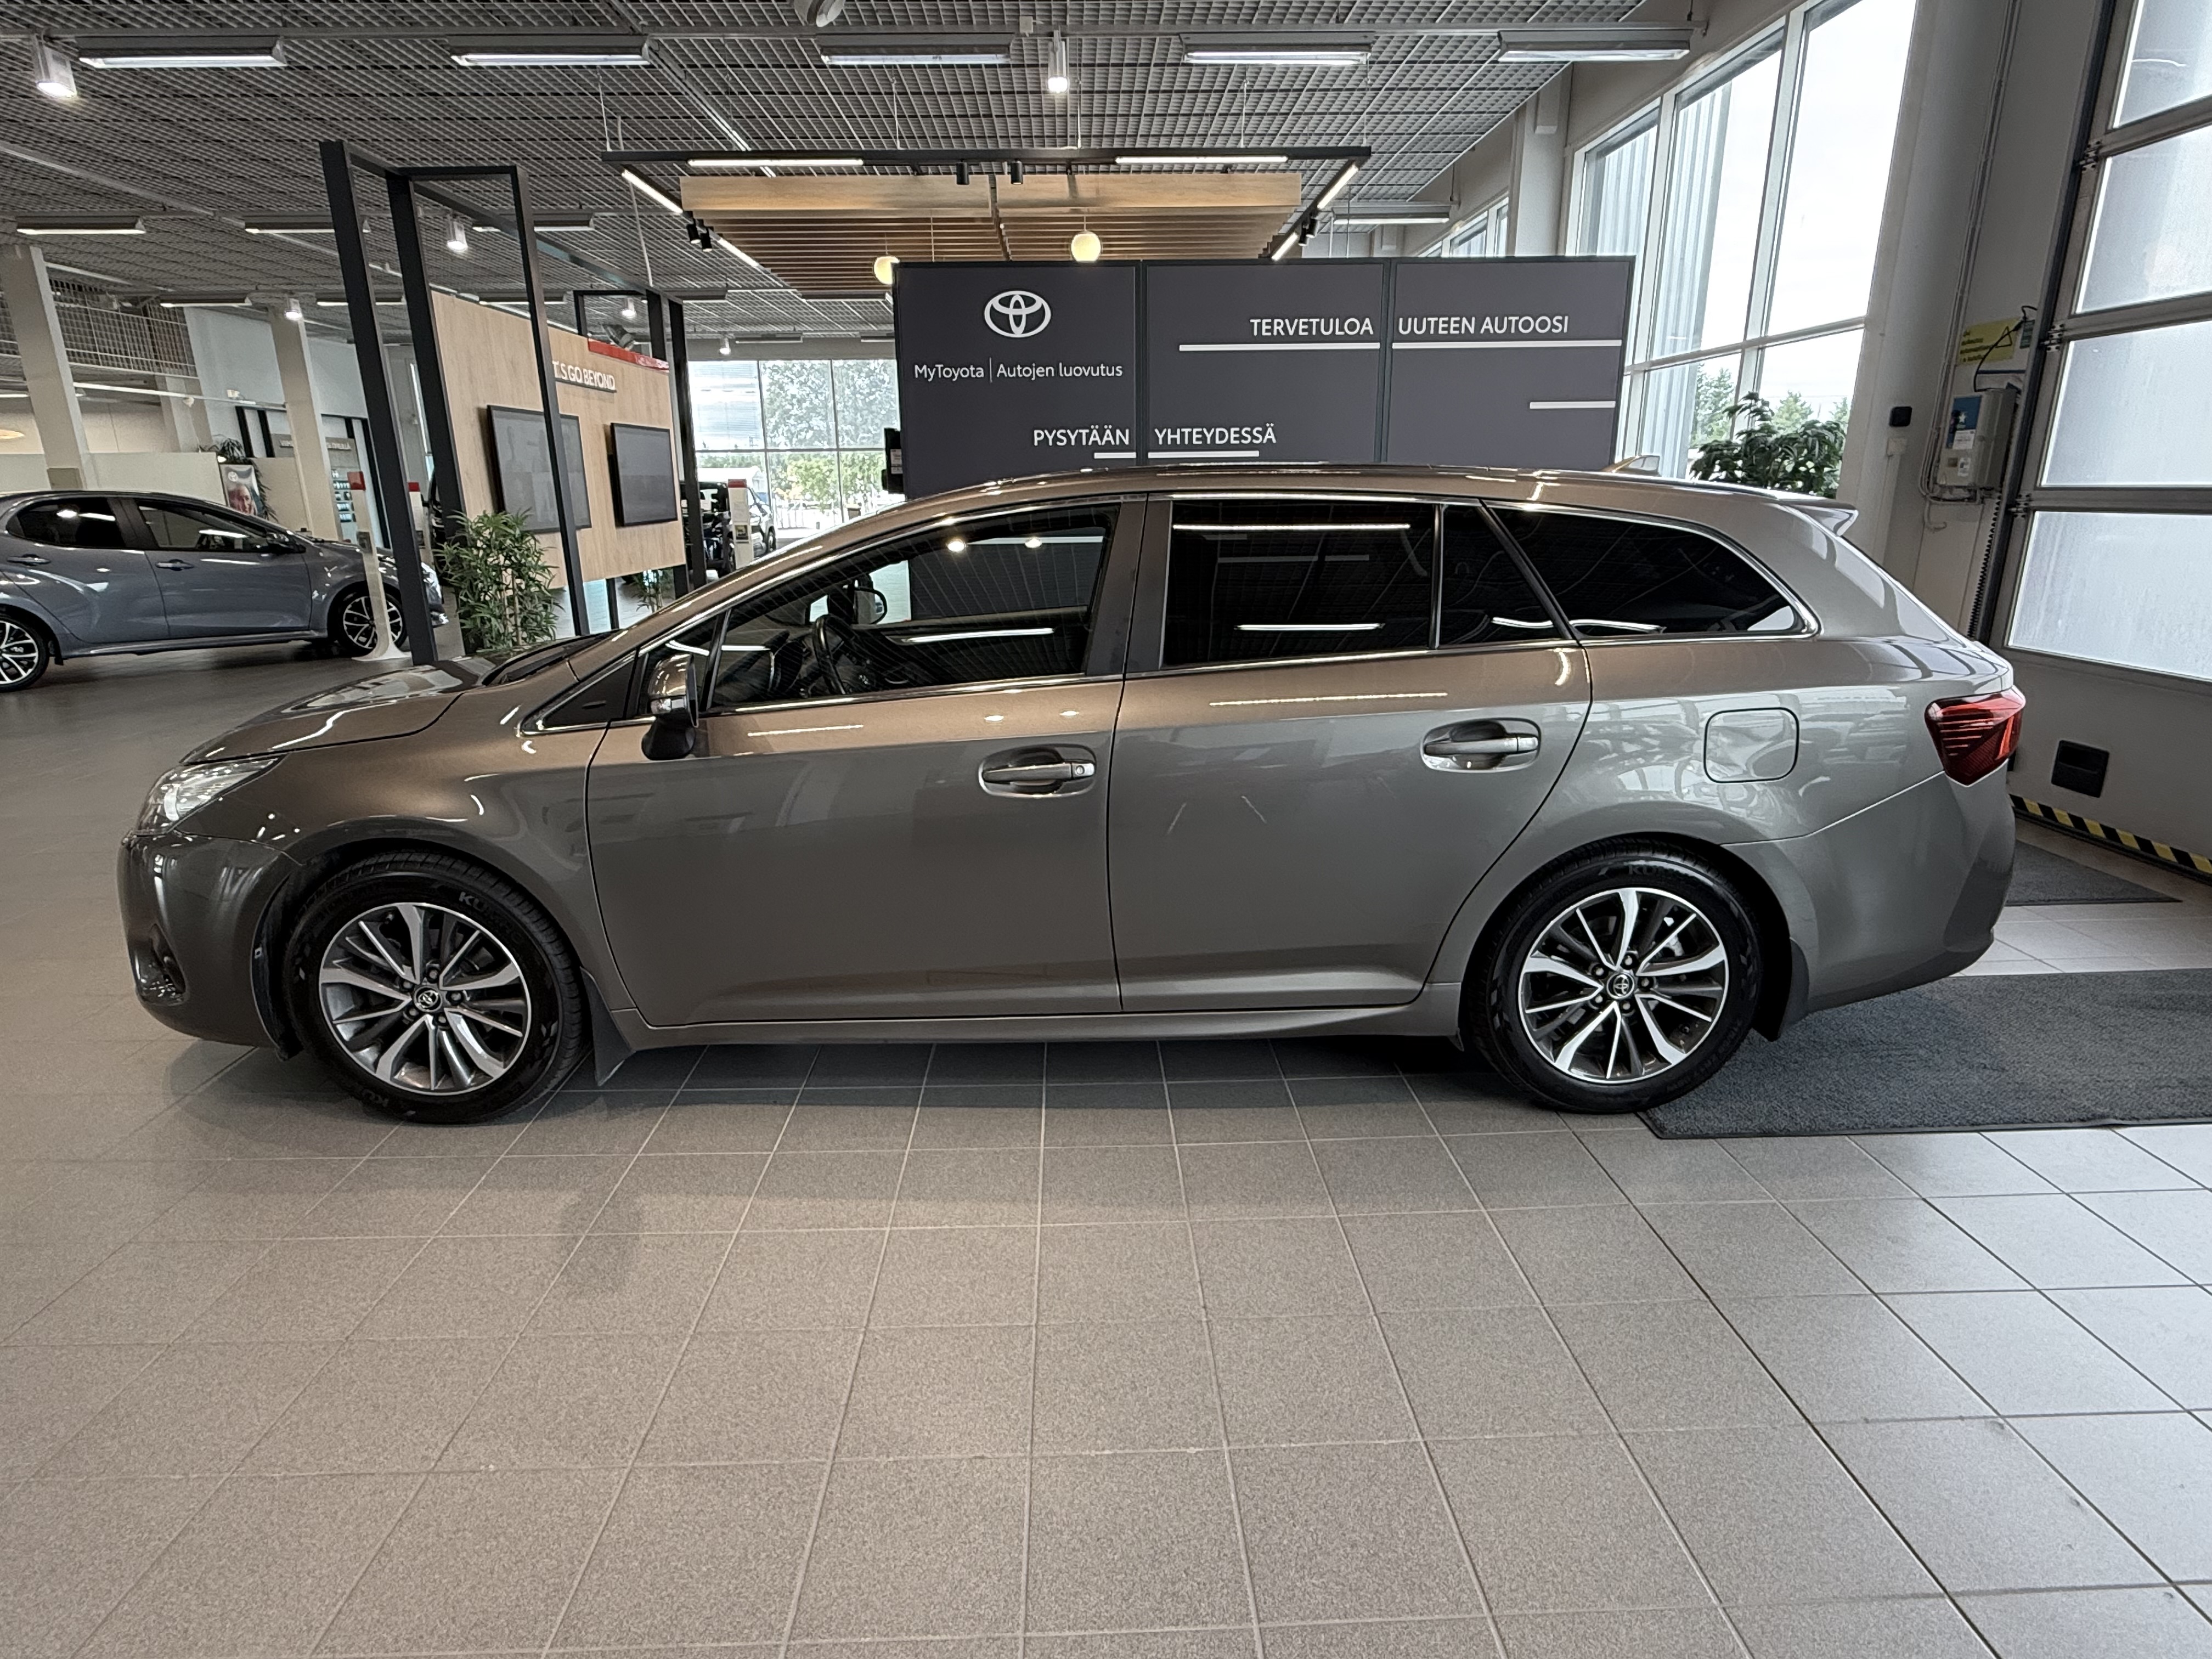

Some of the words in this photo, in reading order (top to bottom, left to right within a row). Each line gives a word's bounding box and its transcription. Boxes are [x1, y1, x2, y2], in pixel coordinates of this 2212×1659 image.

[1250, 318, 1374, 336] TERVETULOA
[1398, 317, 1476, 335] UUTEEN
[1480, 315, 1569, 334] AUTOOSI
[567, 364, 583, 383] GO
[583, 369, 616, 390] BEYOND
[915, 364, 984, 382] MyToyota
[996, 363, 1054, 381] Autojen
[1059, 362, 1122, 376] luovutus
[1034, 425, 1129, 446] PYSYTÄÄN
[1154, 422, 1277, 445] YHTEYDESSÄ
